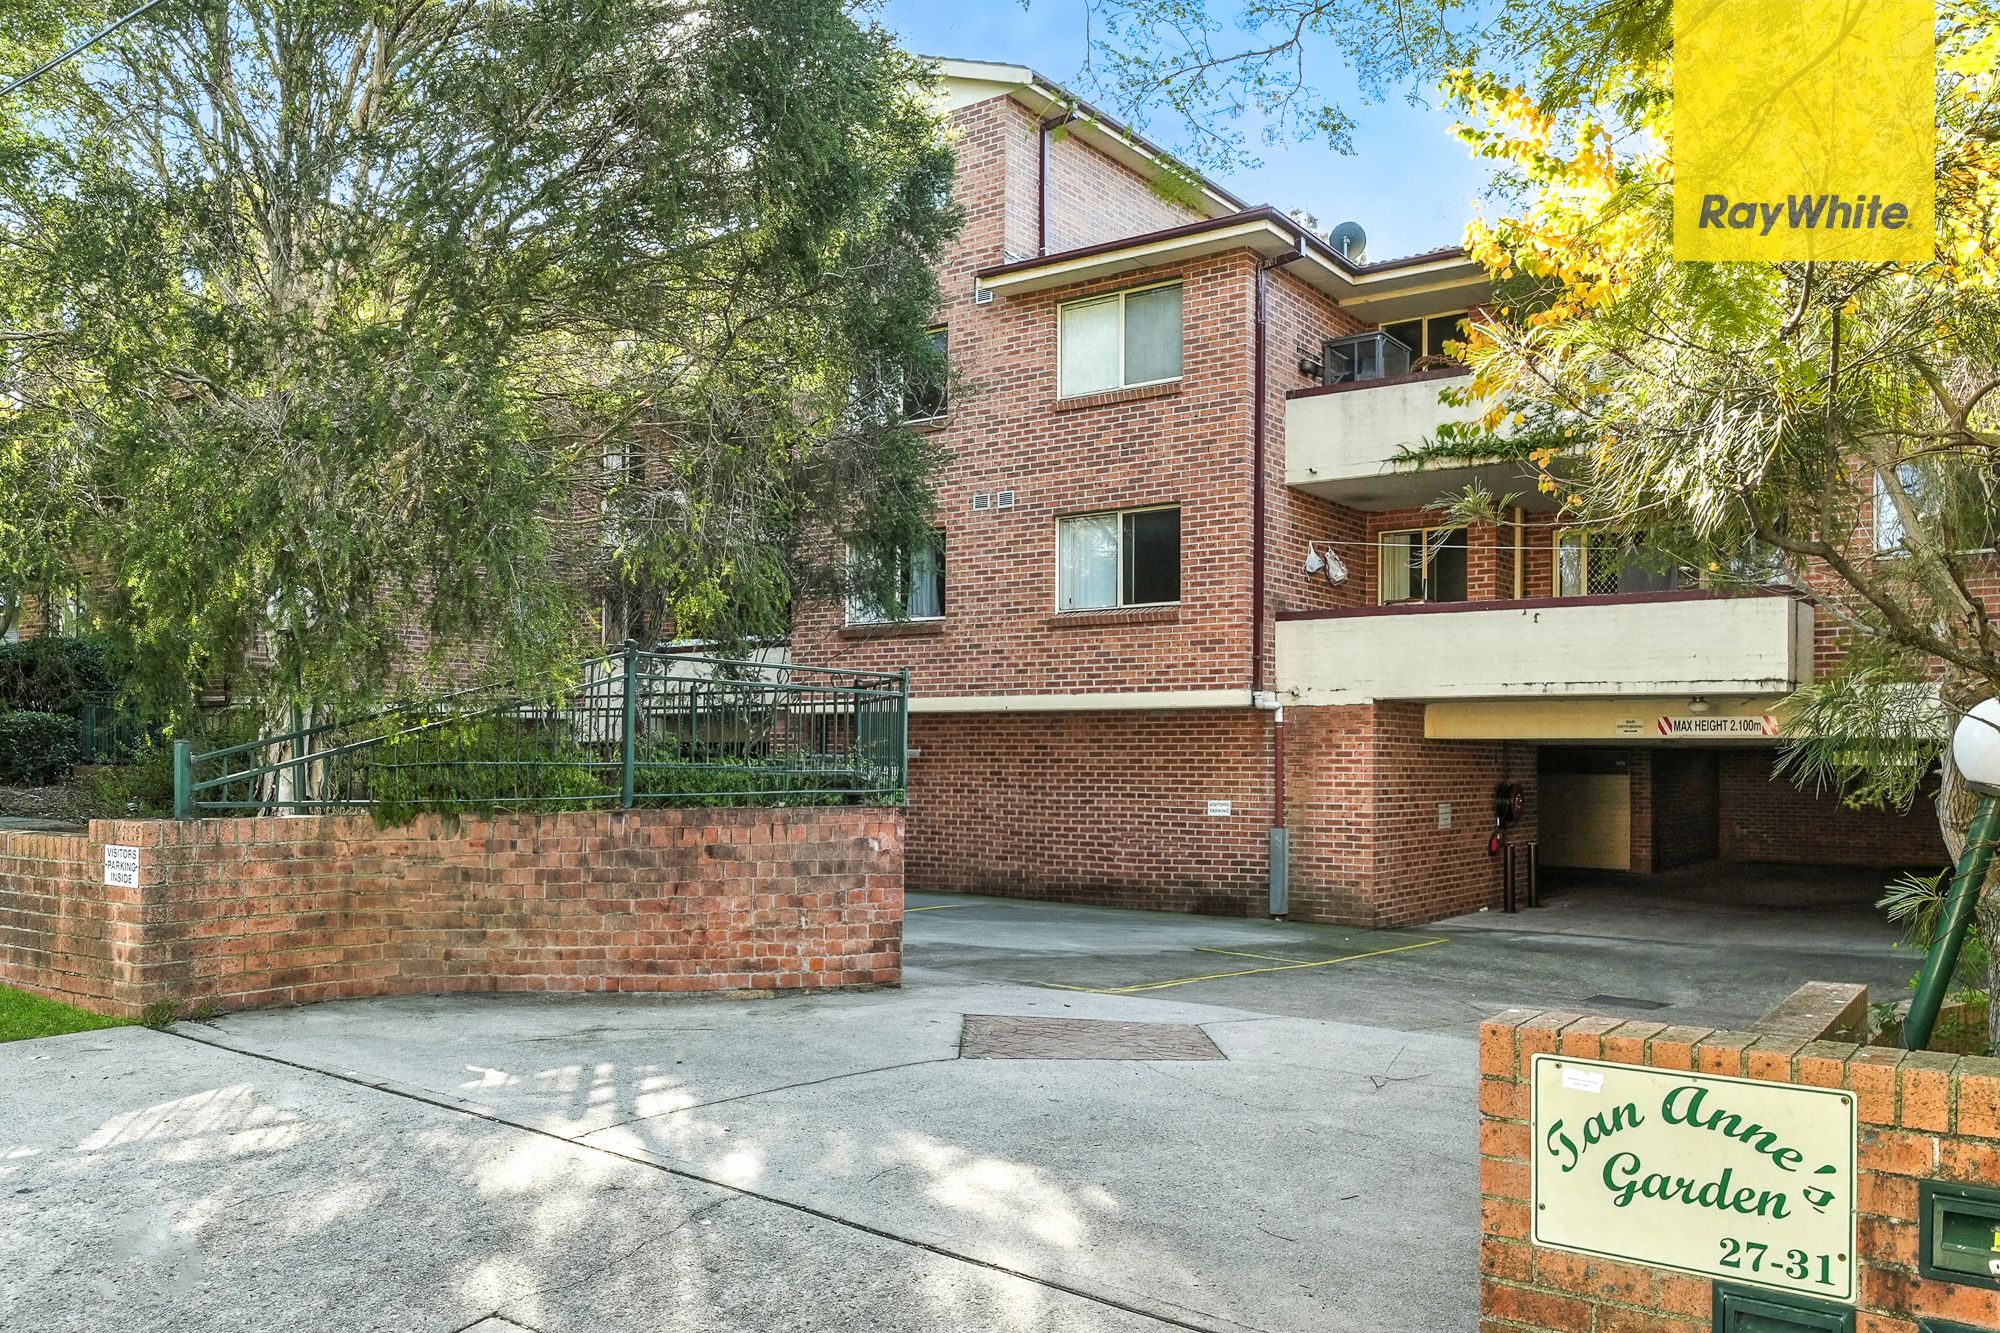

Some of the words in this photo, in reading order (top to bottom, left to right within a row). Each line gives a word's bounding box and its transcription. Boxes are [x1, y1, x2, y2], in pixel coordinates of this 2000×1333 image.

[1673, 719, 1693, 732] MAX
[1694, 719, 1728, 732] HEIGHT
[1730, 719, 1762, 732] 2.100m
[106, 847, 137, 860] VISITORS
[106, 860, 137, 872] PARKING
[110, 872, 132, 884] INSIDE
[1603, 1152, 1791, 1219] Garden
[1718, 1237, 1836, 1286] 27-31
